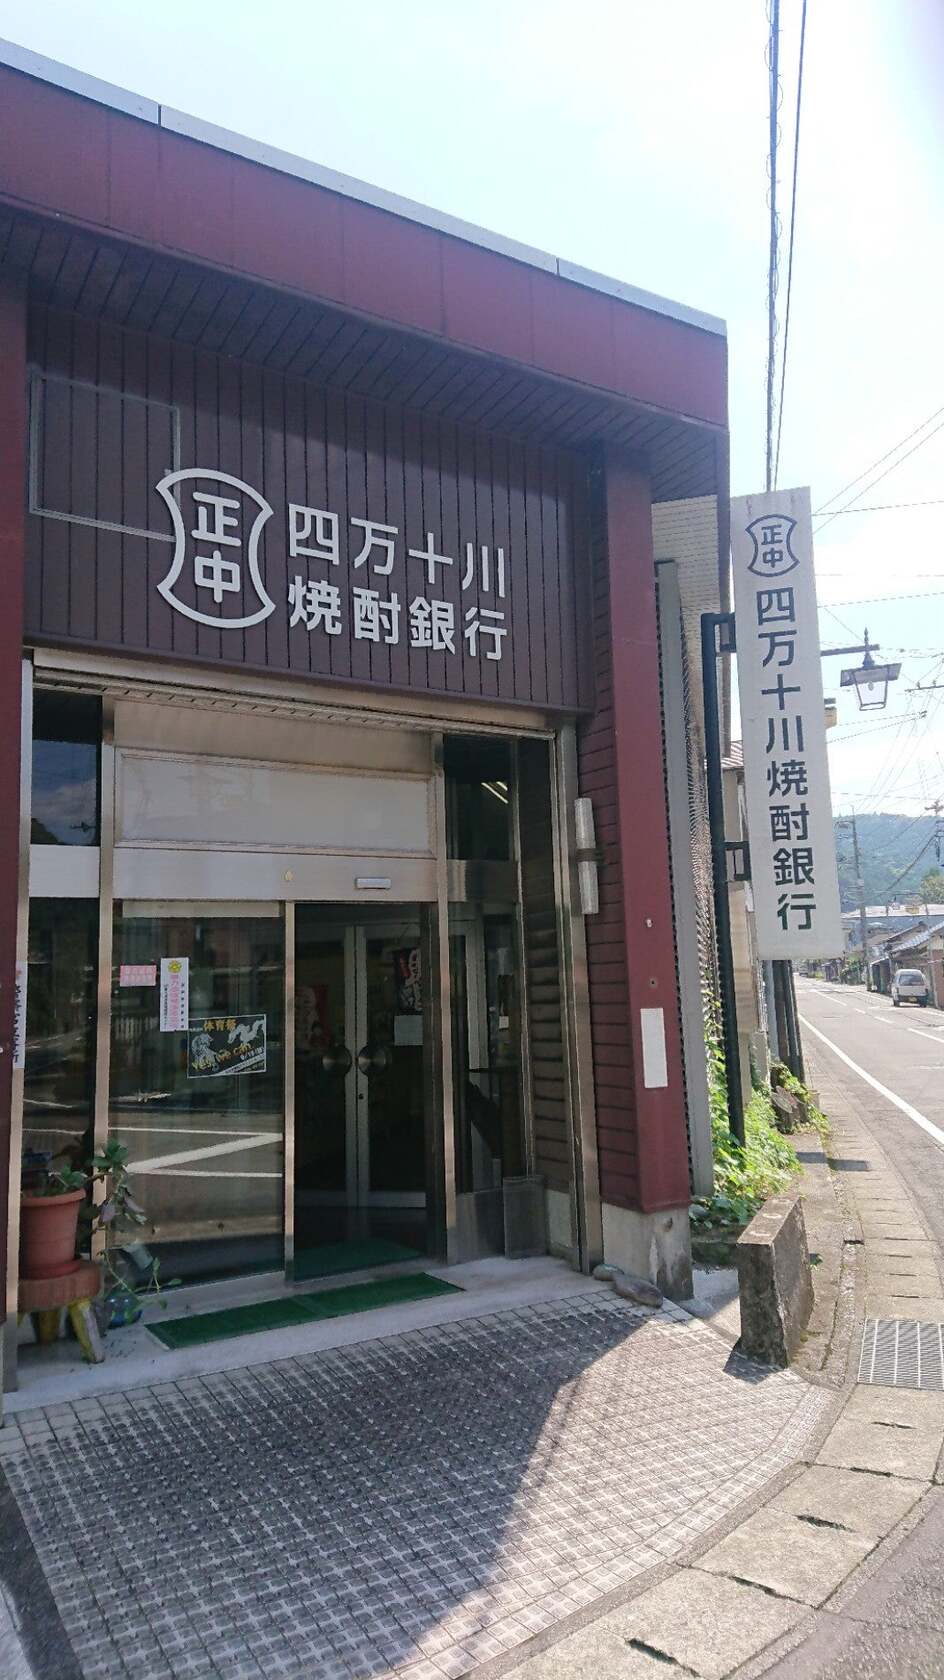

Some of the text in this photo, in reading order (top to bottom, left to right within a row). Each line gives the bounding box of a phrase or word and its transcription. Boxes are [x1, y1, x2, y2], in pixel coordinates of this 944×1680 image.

[191, 491, 242, 604] 正中
[287, 503, 506, 599] 四万十川
[759, 523, 784, 569] 正中
[287, 575, 508, 661] 焼酎銀行
[756, 586, 817, 931] 四万十川焼酎銀行
